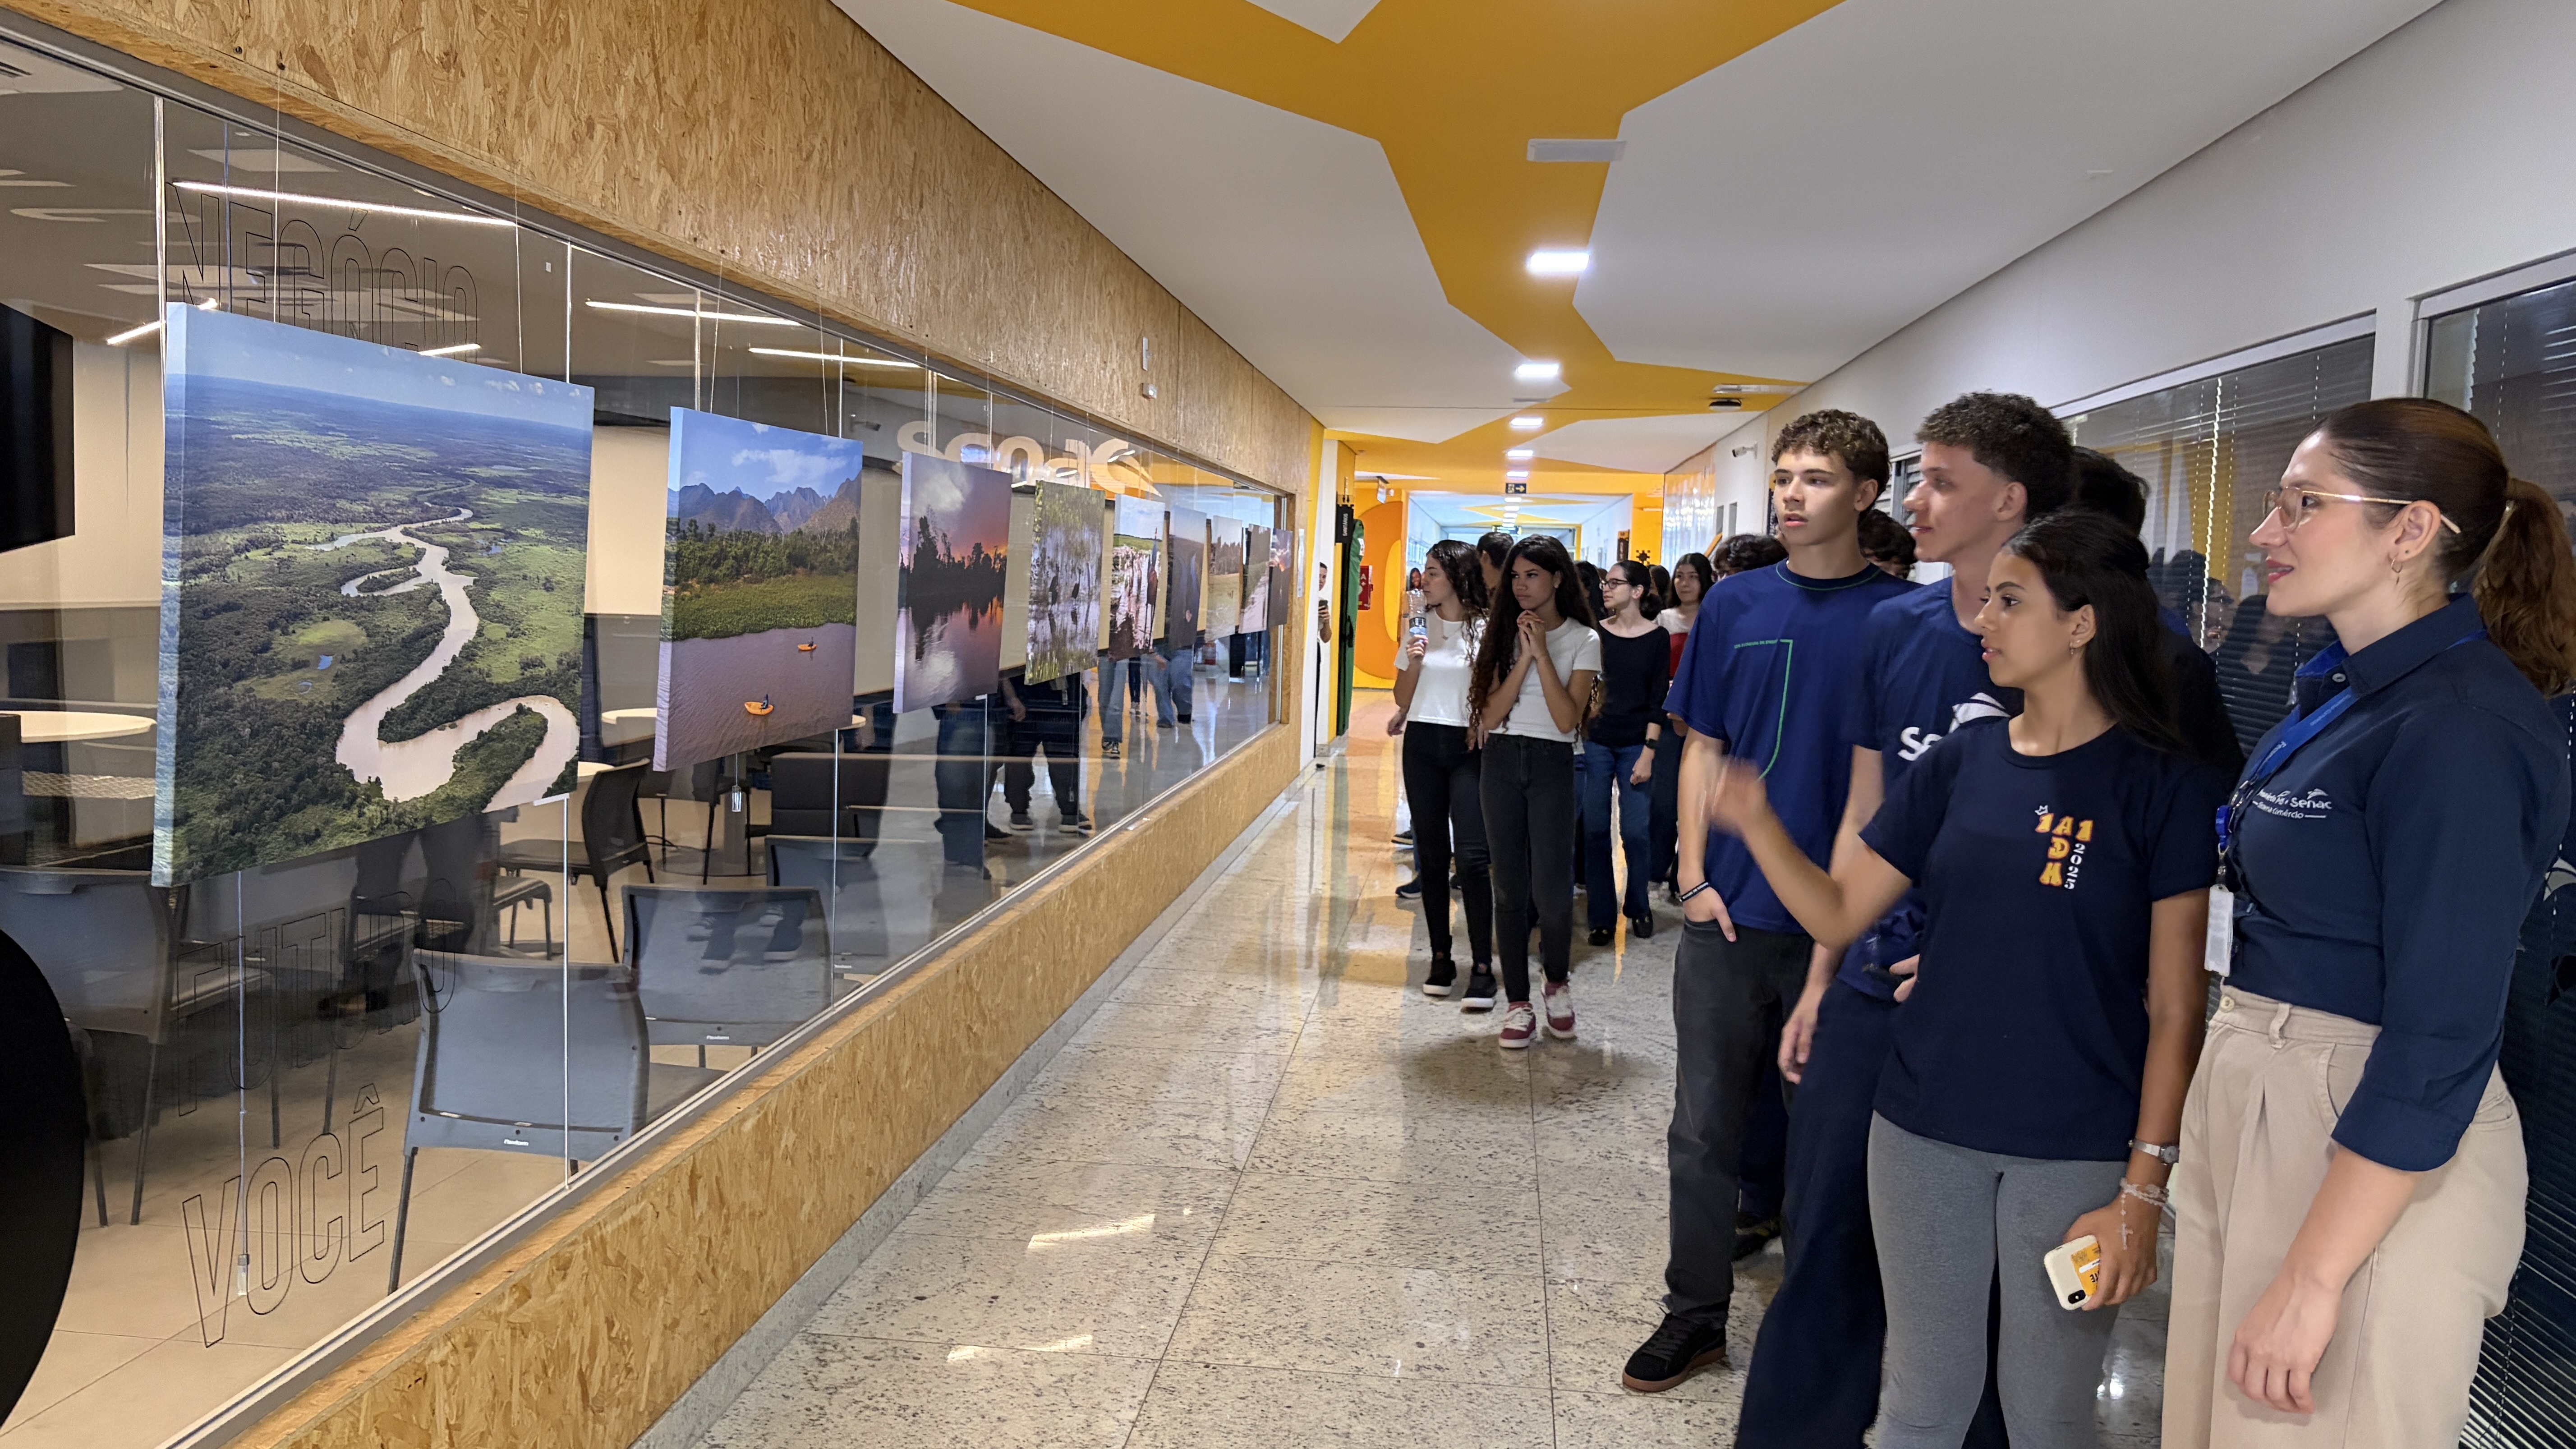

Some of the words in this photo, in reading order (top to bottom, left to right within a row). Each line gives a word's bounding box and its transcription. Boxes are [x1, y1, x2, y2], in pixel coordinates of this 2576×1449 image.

[166, 181, 478, 364] NEGÓCIO
[2064, 843, 2085, 889] 2025
[2290, 797, 2332, 810] Senac
[177, 878, 456, 1117] FUTURO
[182, 1082, 384, 1348] VOCÊ
